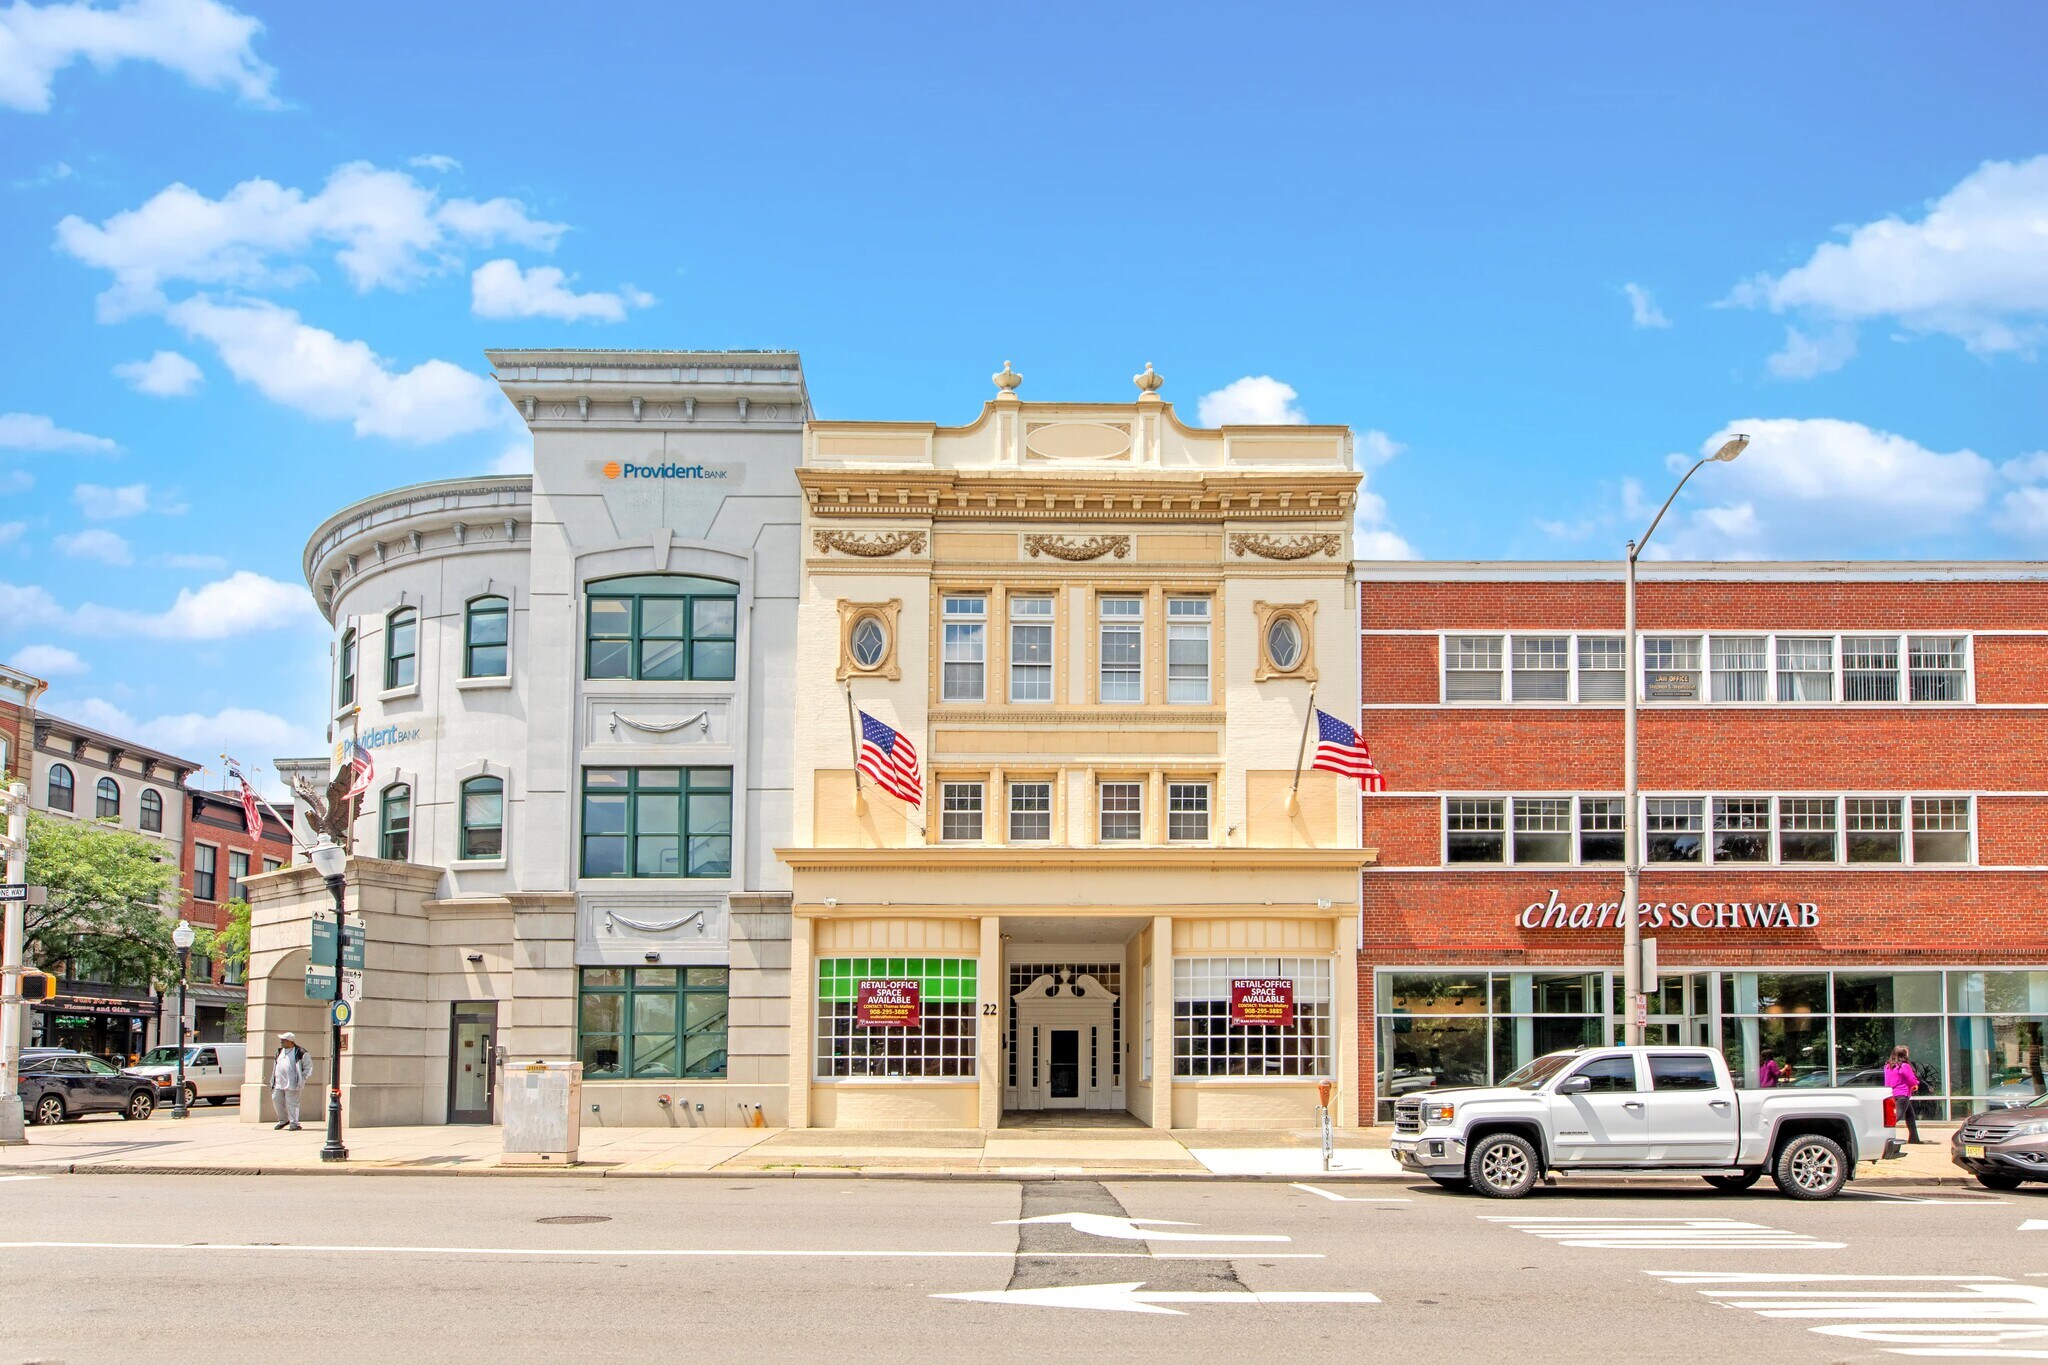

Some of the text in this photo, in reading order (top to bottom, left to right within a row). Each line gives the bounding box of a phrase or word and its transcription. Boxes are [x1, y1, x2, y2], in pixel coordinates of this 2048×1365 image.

[624, 463, 704, 478] Provident
[344, 725, 420, 760] Prvident BANK
[1670, 902, 1820, 928] SCHWAB
[983, 1004, 997, 1015] 22
